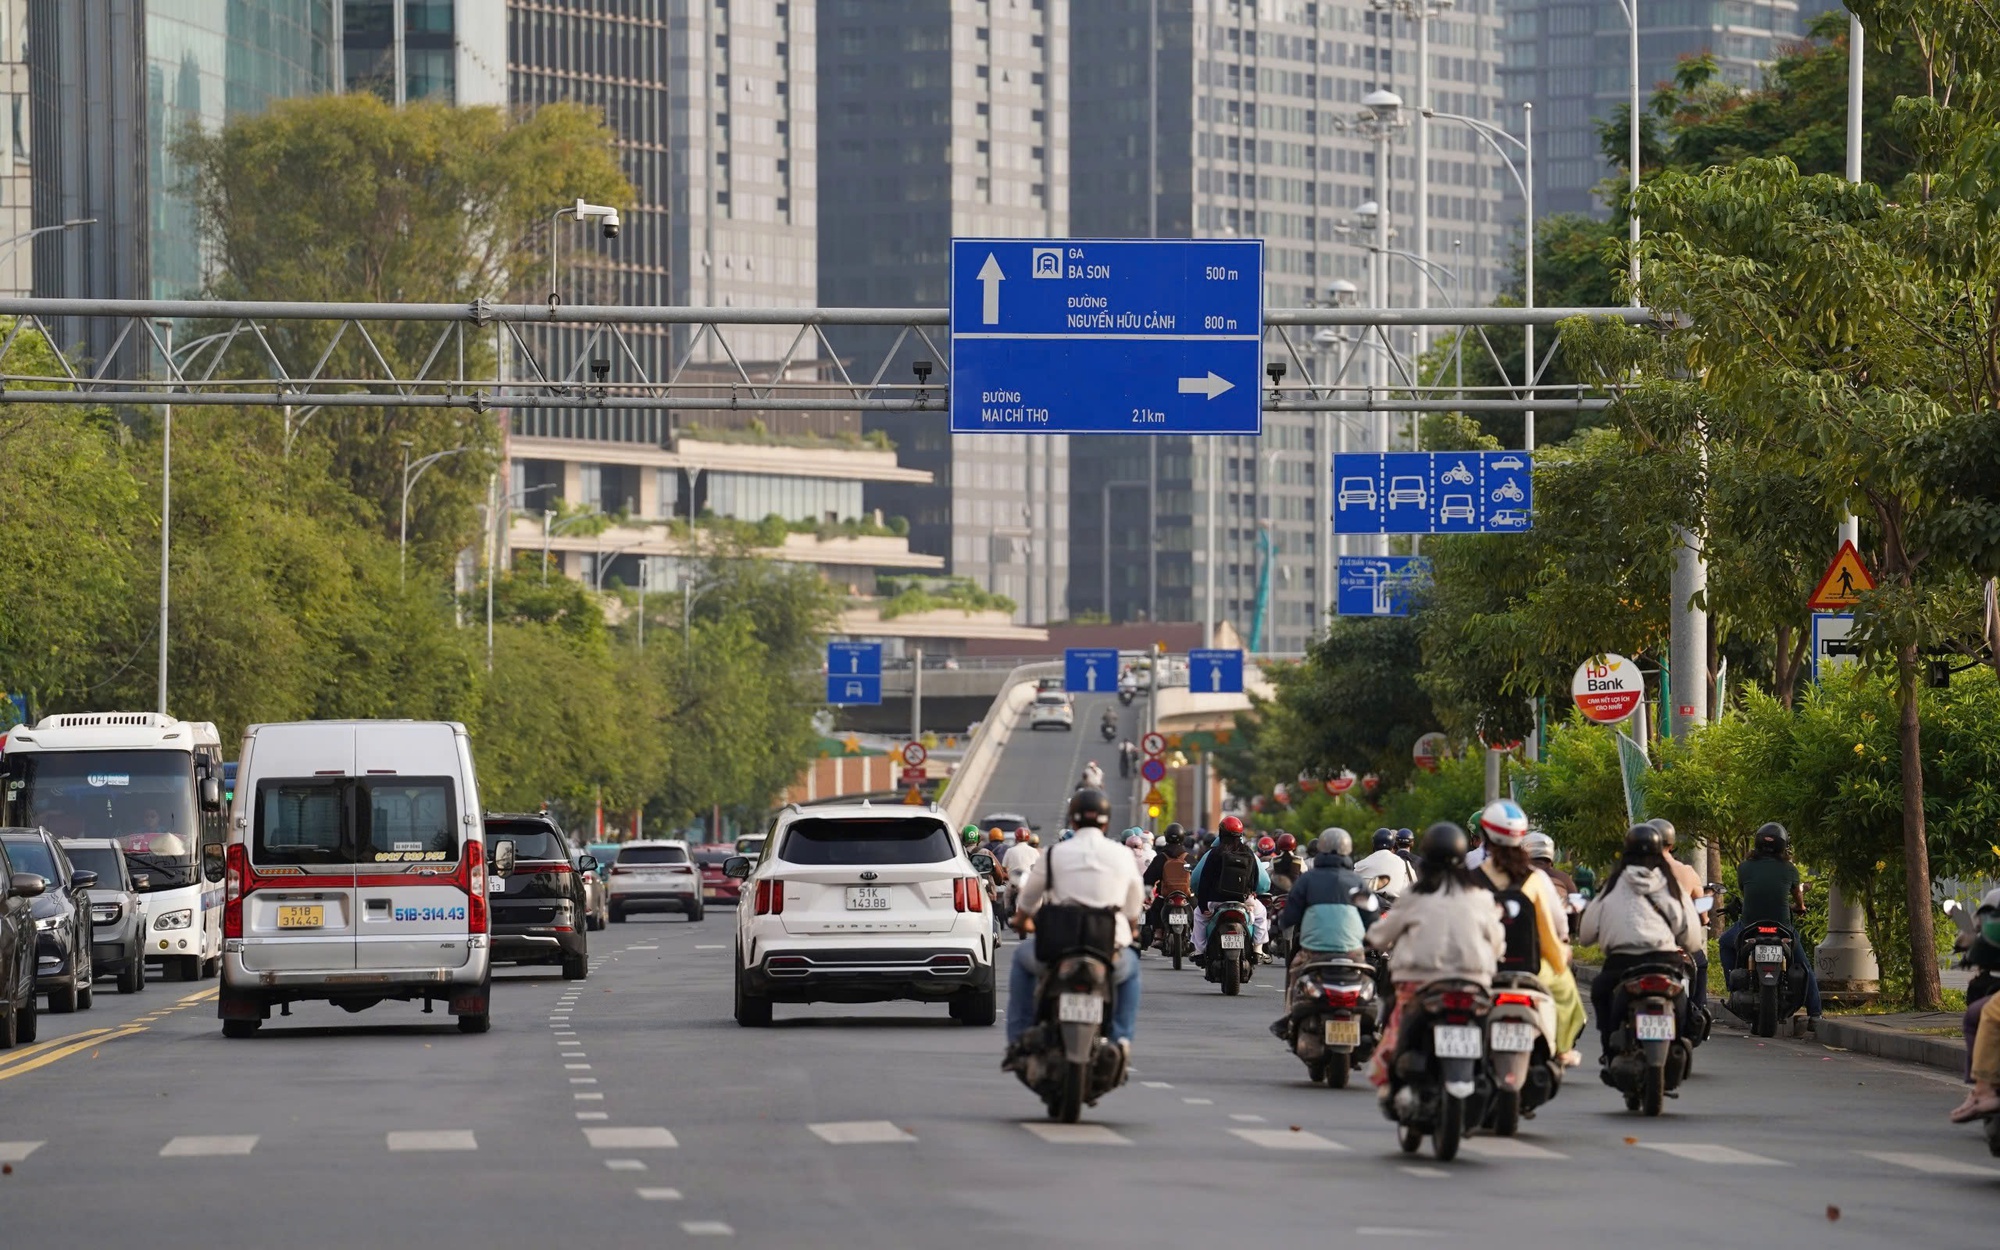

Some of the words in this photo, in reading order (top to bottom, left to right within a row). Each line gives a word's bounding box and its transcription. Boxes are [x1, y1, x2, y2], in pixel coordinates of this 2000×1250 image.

[1068, 248, 1084, 259] GA
[1068, 265, 1084, 279] BA
[1086, 265, 1110, 279] SON
[1206, 266, 1226, 280] 500
[1228, 270, 1238, 280] m
[1068, 294, 1107, 308] ĐƯỜNG
[1068, 310, 1114, 328] NGUYỄN
[1116, 312, 1141, 328] HỮU
[1144, 310, 1175, 328] CẢNH
[1204, 316, 1224, 329] 800
[1226, 319, 1237, 329] m
[982, 388, 1021, 403] ĐƯỜNG
[982, 408, 1003, 422] MAI
[1005, 405, 1024, 422] CHÍ
[1026, 408, 1048, 425] THỌ
[1587, 666, 1608, 678] HD
[1588, 678, 1624, 691] Bank
[859, 889, 877, 898] 51K
[852, 899, 886, 908] 143.88
[291, 907, 310, 916] 51B
[395, 907, 465, 921] 51B-314.43
[283, 917, 319, 926] 314.43
